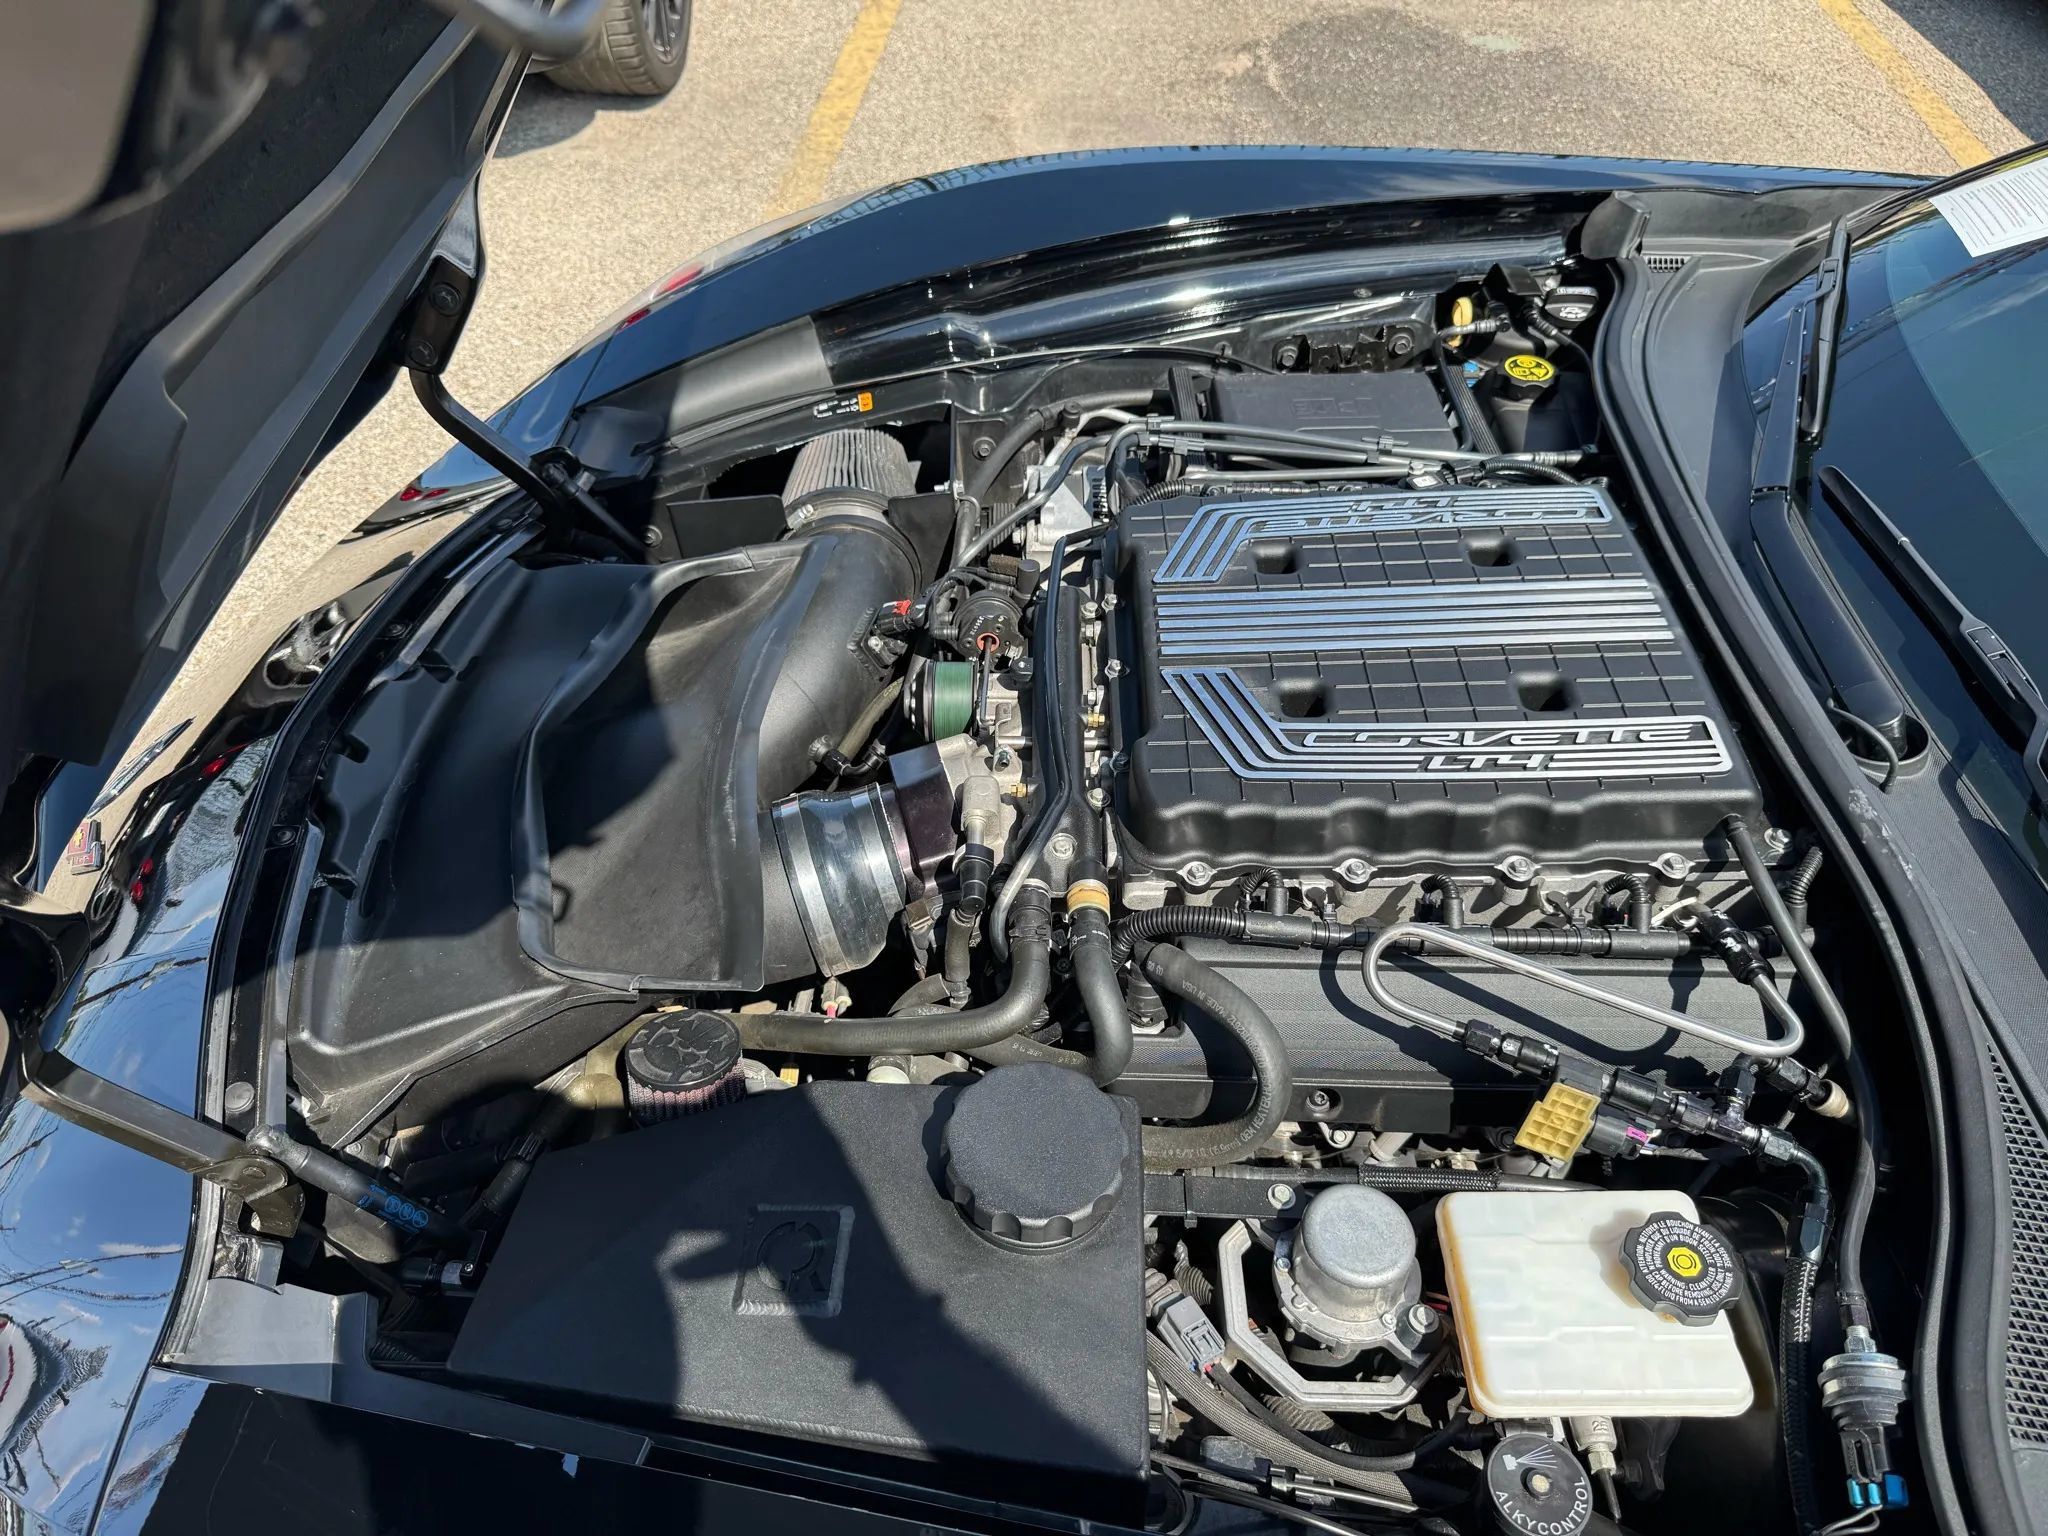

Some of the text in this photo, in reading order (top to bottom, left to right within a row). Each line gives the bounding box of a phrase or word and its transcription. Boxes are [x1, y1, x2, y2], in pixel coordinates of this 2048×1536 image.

[1263, 507, 1588, 529] CORVETTE
[1303, 722, 1694, 749] CORVETTE
[1427, 752, 1549, 773] LT4
[1182, 979, 1199, 997] USA
[1206, 997, 1228, 1018] MADE
[1252, 1096, 1271, 1129] HEATER
[1639, 1223, 1660, 1244] NETTOYER
[1657, 1220, 1667, 1228] LE
[1666, 1219, 1694, 1230] BOUCHON
[1694, 1226, 1713, 1240] AVANT
[1651, 1231, 1661, 1240] QUE
[1660, 1228, 1671, 1236] DU
[1669, 1227, 1692, 1236] LIQUIDE
[1692, 1232, 1701, 1241] DE
[1700, 1237, 1716, 1254] FREIN
[1652, 1238, 1665, 1268] PROVENANT
[1679, 1234, 1698, 1246] BIDON
[1697, 1244, 1715, 1265] SCELLE
[1711, 1239, 1721, 1248] LA
[1636, 1244, 1649, 1273] ATTENTION:
[1652, 1271, 1664, 1281] CAP
[1661, 1279, 1684, 1296] BEFORE
[1676, 1295, 1694, 1306] FROM
[1699, 1294, 1720, 1307] SEALED
[1496, 1477, 1588, 1535] ALKYCONTROL
